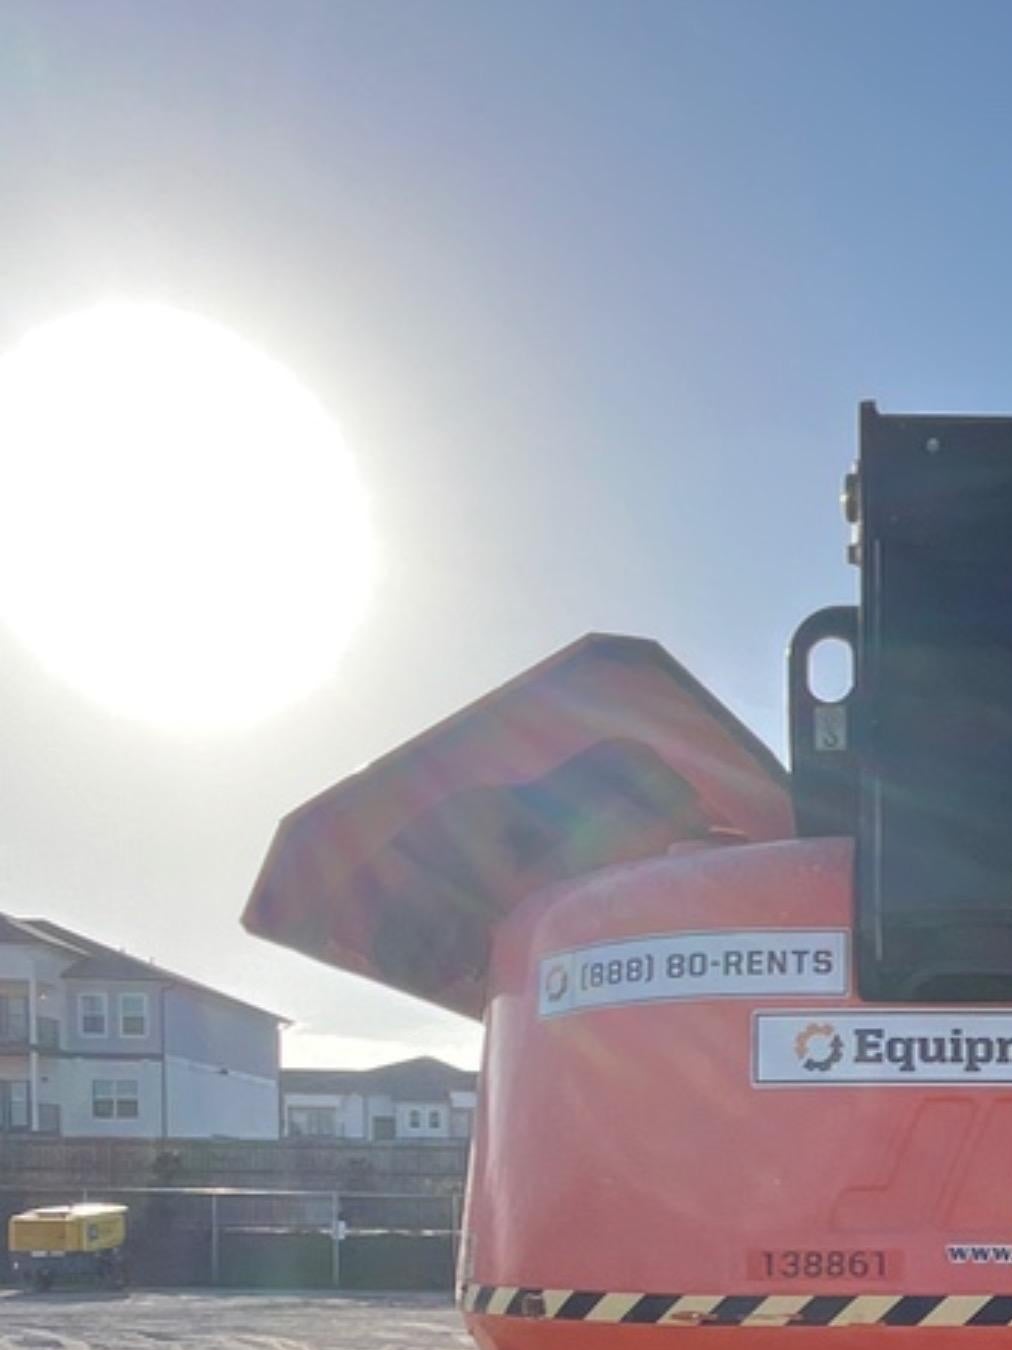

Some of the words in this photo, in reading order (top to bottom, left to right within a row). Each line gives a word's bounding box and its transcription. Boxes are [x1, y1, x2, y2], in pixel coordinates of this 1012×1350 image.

[579, 957, 654, 991] (888)
[665, 950, 834, 980] 80-RENTS
[760, 1250, 888, 1279] 138861
